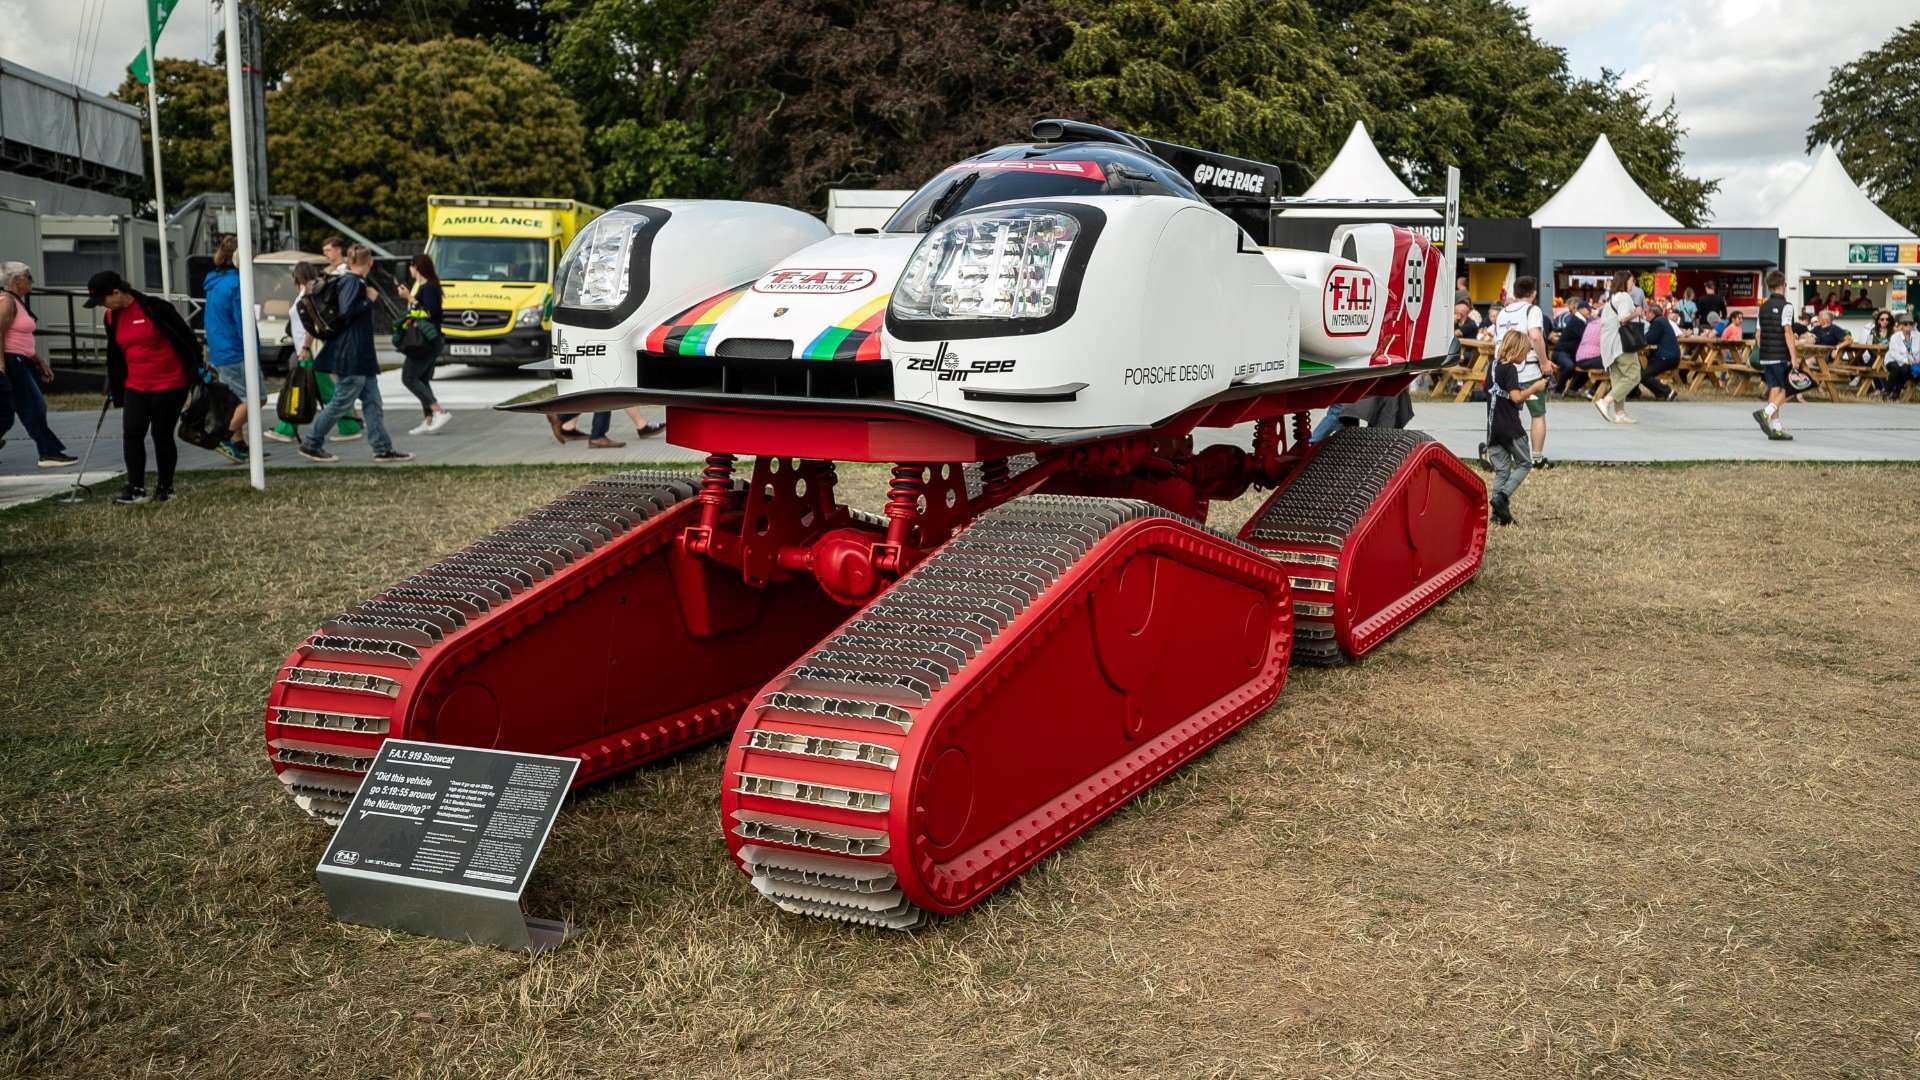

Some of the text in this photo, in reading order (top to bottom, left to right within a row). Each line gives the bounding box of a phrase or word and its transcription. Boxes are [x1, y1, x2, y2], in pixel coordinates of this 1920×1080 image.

[1194, 163, 1265, 193] GP ICE RACE
[443, 216, 544, 228] AMBULANCE
[1619, 239, 1637, 249] Real
[1638, 239, 1673, 250] German
[1674, 239, 1708, 253] Sausage
[1332, 276, 1372, 311] F.A.T.
[1332, 314, 1369, 326] INTERNATIONAL
[576, 345, 607, 356] see
[970, 360, 1016, 374] see
[1124, 364, 1215, 386] PORSCHE DESIGN
[388, 748, 455, 765] F.A.T. 919 Snowcat
[390, 772, 405, 784] this
[406, 774, 433, 787] vehicle
[369, 785, 437, 801] go 5:19:55 around
[363, 797, 376, 808] the
